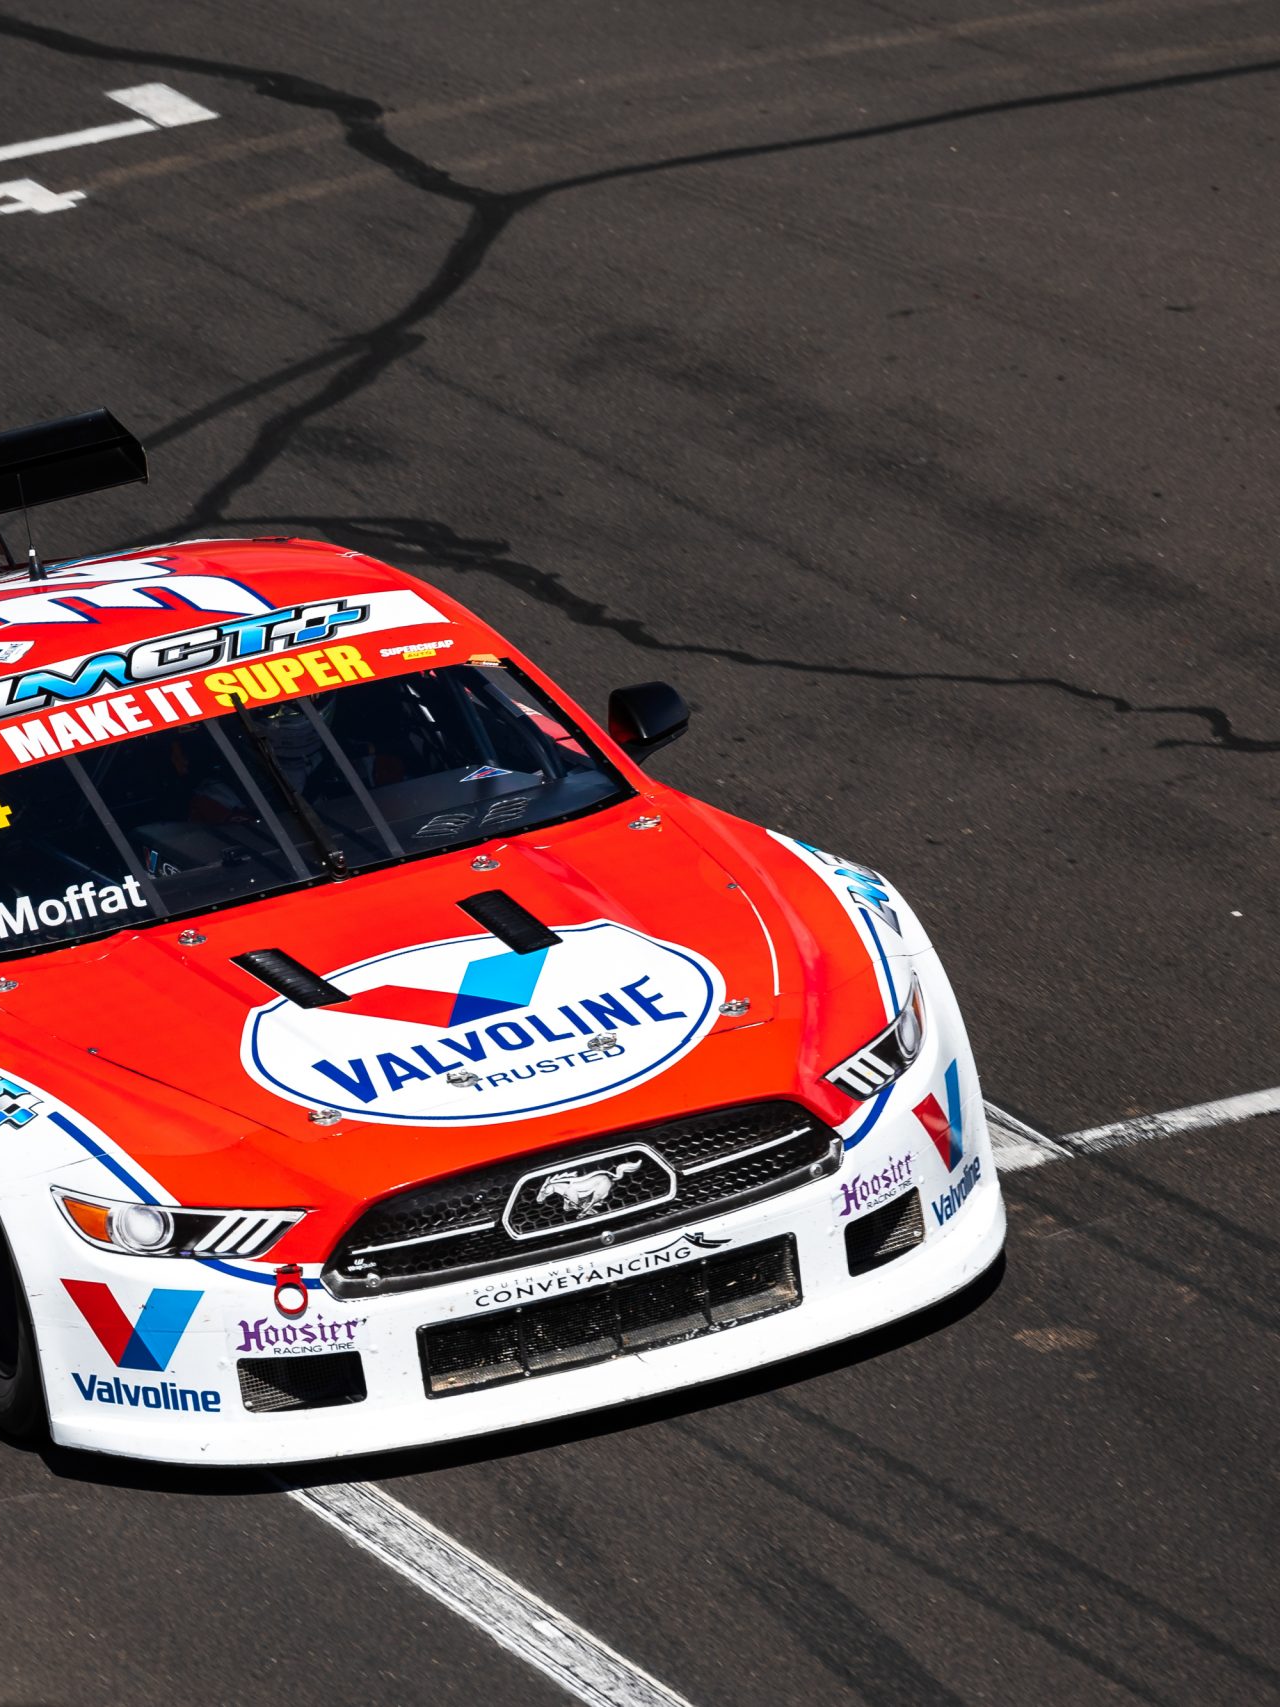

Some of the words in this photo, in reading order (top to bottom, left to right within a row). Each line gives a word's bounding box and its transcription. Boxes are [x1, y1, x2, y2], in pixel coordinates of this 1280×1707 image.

[380, 639, 454, 658] SUPERCHEAP
[0, 690, 153, 764] MAKE
[149, 680, 204, 726] IT
[203, 644, 376, 708] SUPER
[311, 975, 687, 1103] VALVOLINE
[471, 1044, 626, 1092] TRUSTED
[839, 1151, 912, 1216] Hoosier
[931, 1155, 982, 1226] Valvoline
[476, 1247, 692, 1307] CONVEYANCING
[236, 1313, 359, 1352] Hoosier
[273, 1344, 323, 1355] RACING
[328, 1341, 355, 1351] TIRE
[71, 1372, 221, 1412] Valvoline
